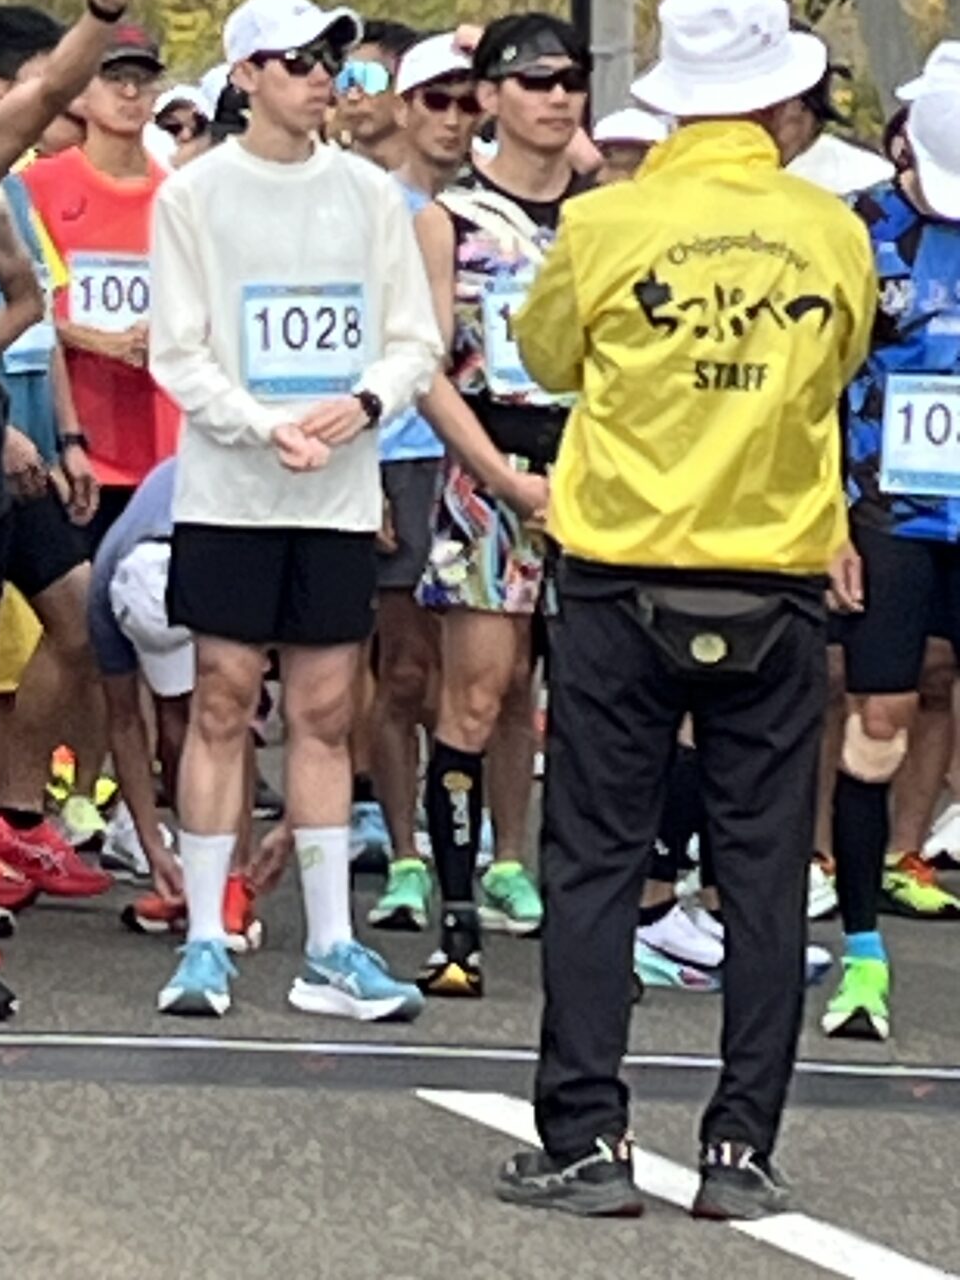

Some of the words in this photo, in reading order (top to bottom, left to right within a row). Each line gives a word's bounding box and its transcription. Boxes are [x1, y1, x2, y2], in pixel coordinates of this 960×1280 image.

[253, 306, 362, 351] 1028
[693, 359, 768, 392] STAFF
[897, 400, 960, 446] 10
